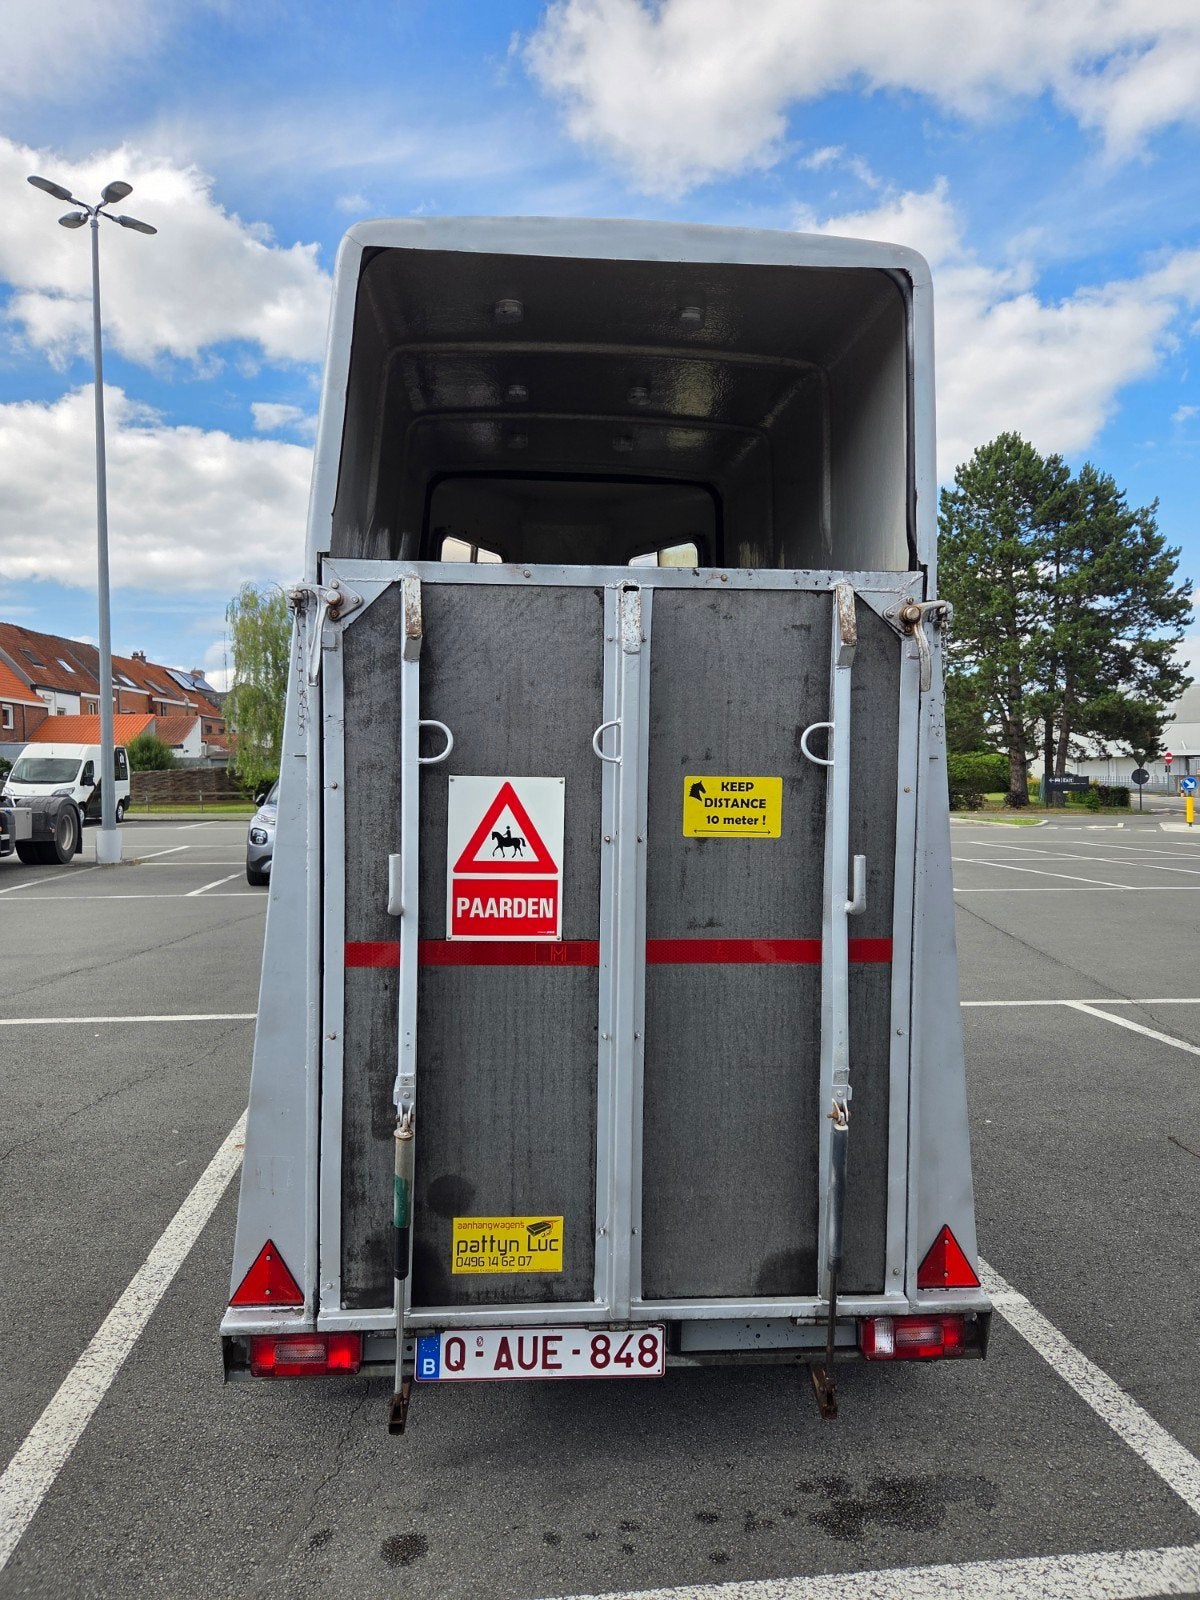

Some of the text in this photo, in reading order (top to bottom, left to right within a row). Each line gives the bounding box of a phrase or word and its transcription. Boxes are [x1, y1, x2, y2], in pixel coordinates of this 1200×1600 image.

[721, 781, 755, 792] KEEP
[704, 797, 767, 809] DISTANCE
[706, 815, 720, 825] 10
[723, 815, 759, 826] meter
[456, 897, 554, 919] PAARDEN
[457, 1221, 525, 1231] aanhangwagens
[456, 1234, 559, 1256] pattyn Luc
[455, 1255, 533, 1268] 0496 14 62 07
[422, 1358, 436, 1375] B
